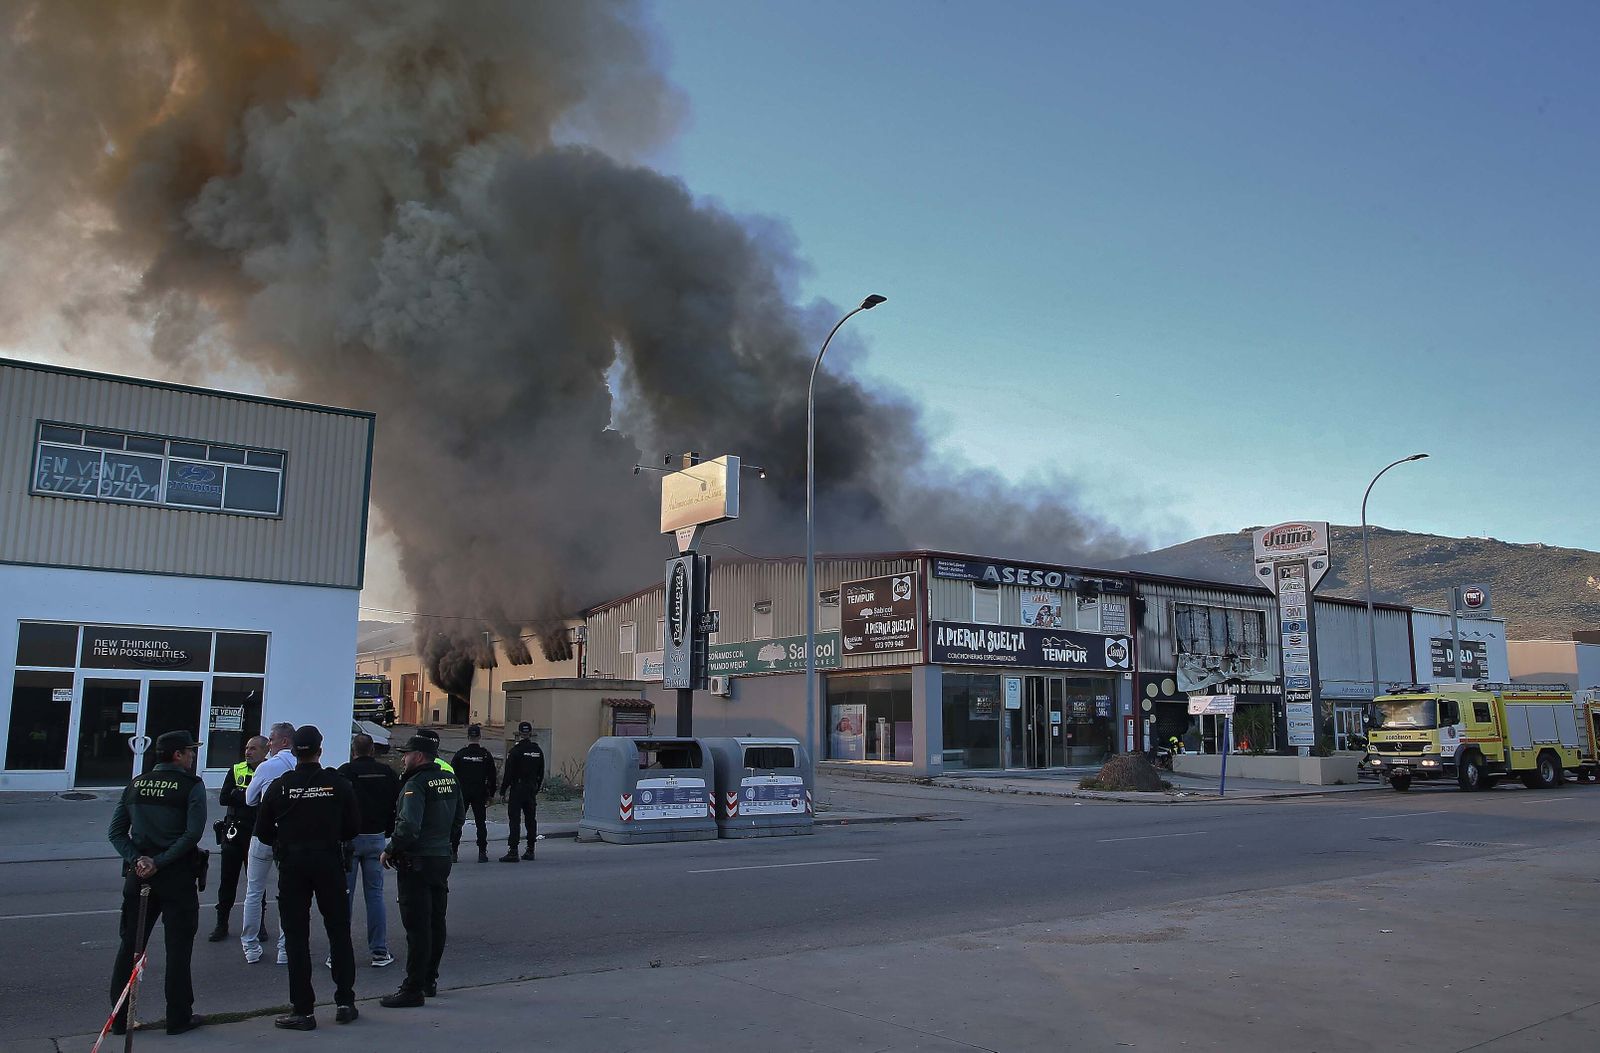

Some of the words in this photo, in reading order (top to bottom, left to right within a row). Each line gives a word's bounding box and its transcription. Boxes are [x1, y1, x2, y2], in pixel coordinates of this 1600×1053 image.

[40, 456, 68, 474] EN
[78, 460, 143, 482] VENTA
[847, 592, 875, 604] TEMPUR
[891, 618, 915, 635] SUELTA
[94, 639, 118, 647] NEW
[119, 640, 171, 650] THINKING.
[937, 627, 945, 646] A
[946, 628, 986, 652] PIERNA
[987, 631, 1026, 653] SUELTA
[93, 647, 118, 656] NEW
[119, 648, 187, 659] POSSIBILITIES.
[732, 650, 744, 659] CON
[1042, 648, 1088, 663] TEMPUR
[789, 658, 835, 668] COLCONES
[134, 780, 178, 790] GUARDIA
[428, 778, 457, 787] GUARDIA
[140, 788, 165, 797] CIVIL
[437, 786, 452, 794] CIVIL
